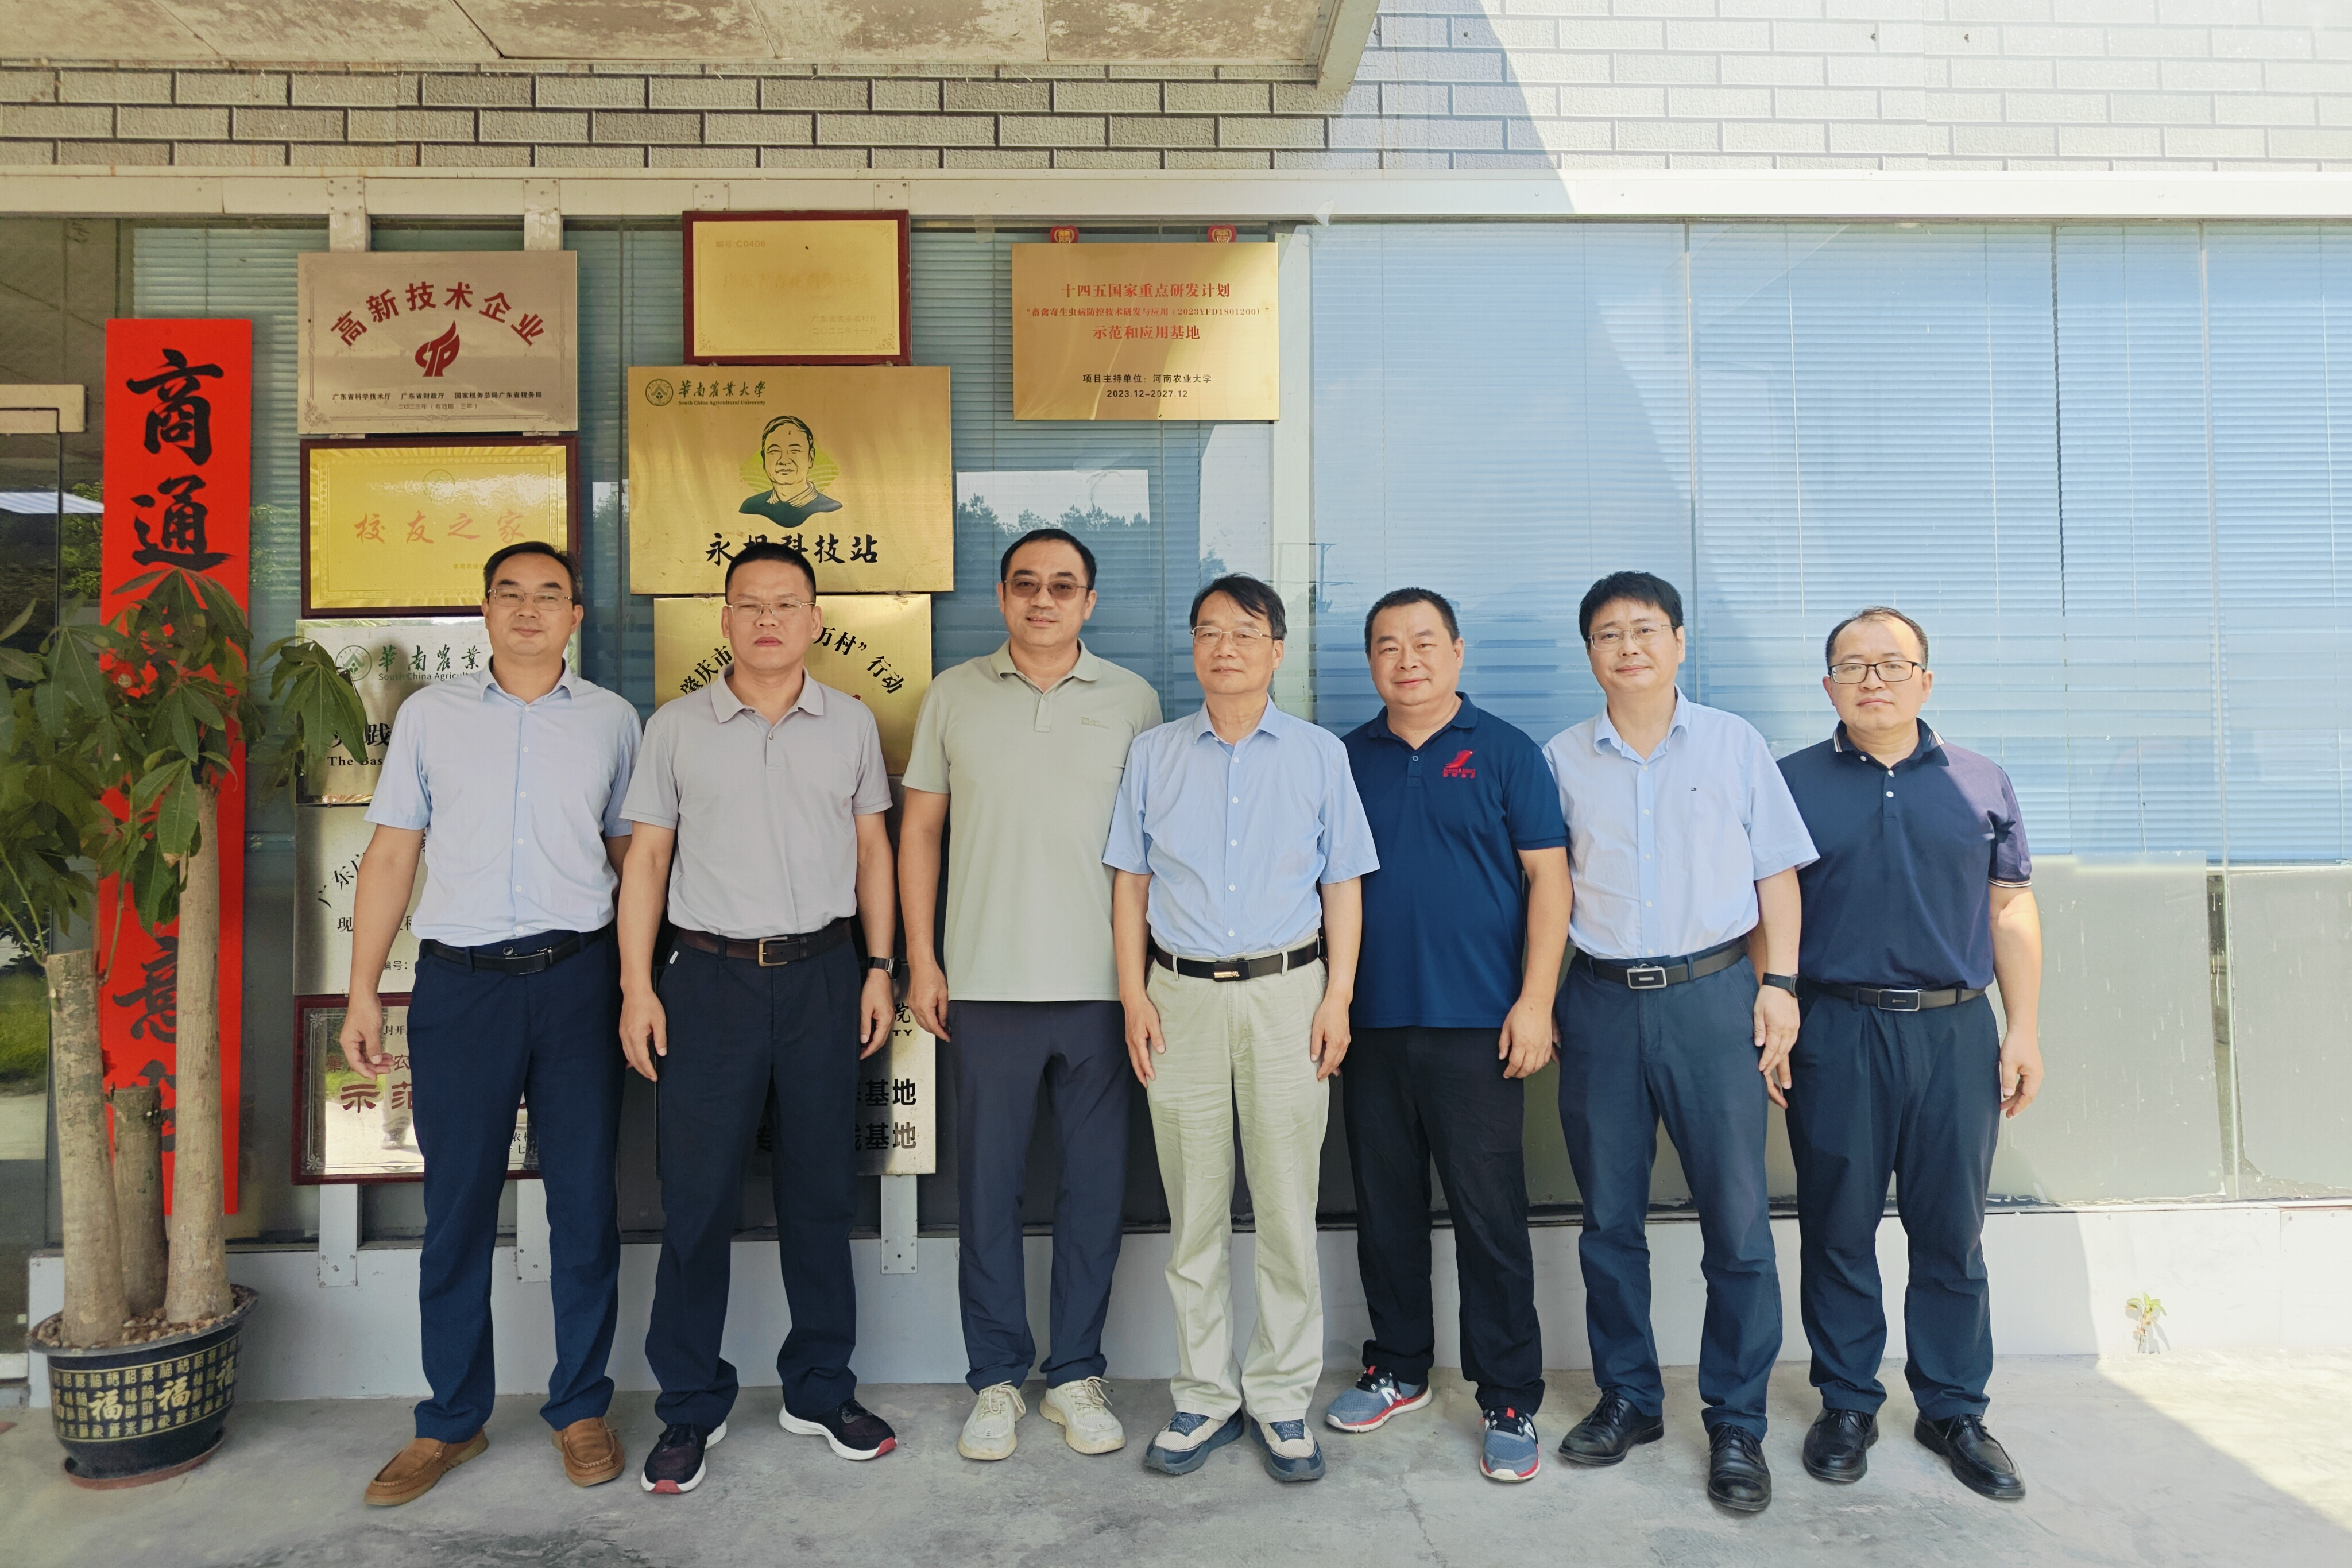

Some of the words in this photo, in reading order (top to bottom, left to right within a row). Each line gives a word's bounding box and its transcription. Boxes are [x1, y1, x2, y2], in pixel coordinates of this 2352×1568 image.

[1061, 283, 1230, 298] 十四五国家重点研发计划
[330, 281, 546, 347] 高新技术企业
[1092, 325, 1200, 340] 示范和应用基地
[1107, 389, 1188, 398] 2023.12-2027.12
[126, 348, 238, 572] 商通
[354, 509, 526, 545] 校友之家
[378, 673, 404, 681] South
[327, 756, 354, 766] The
[857, 1078, 917, 1106] 基地
